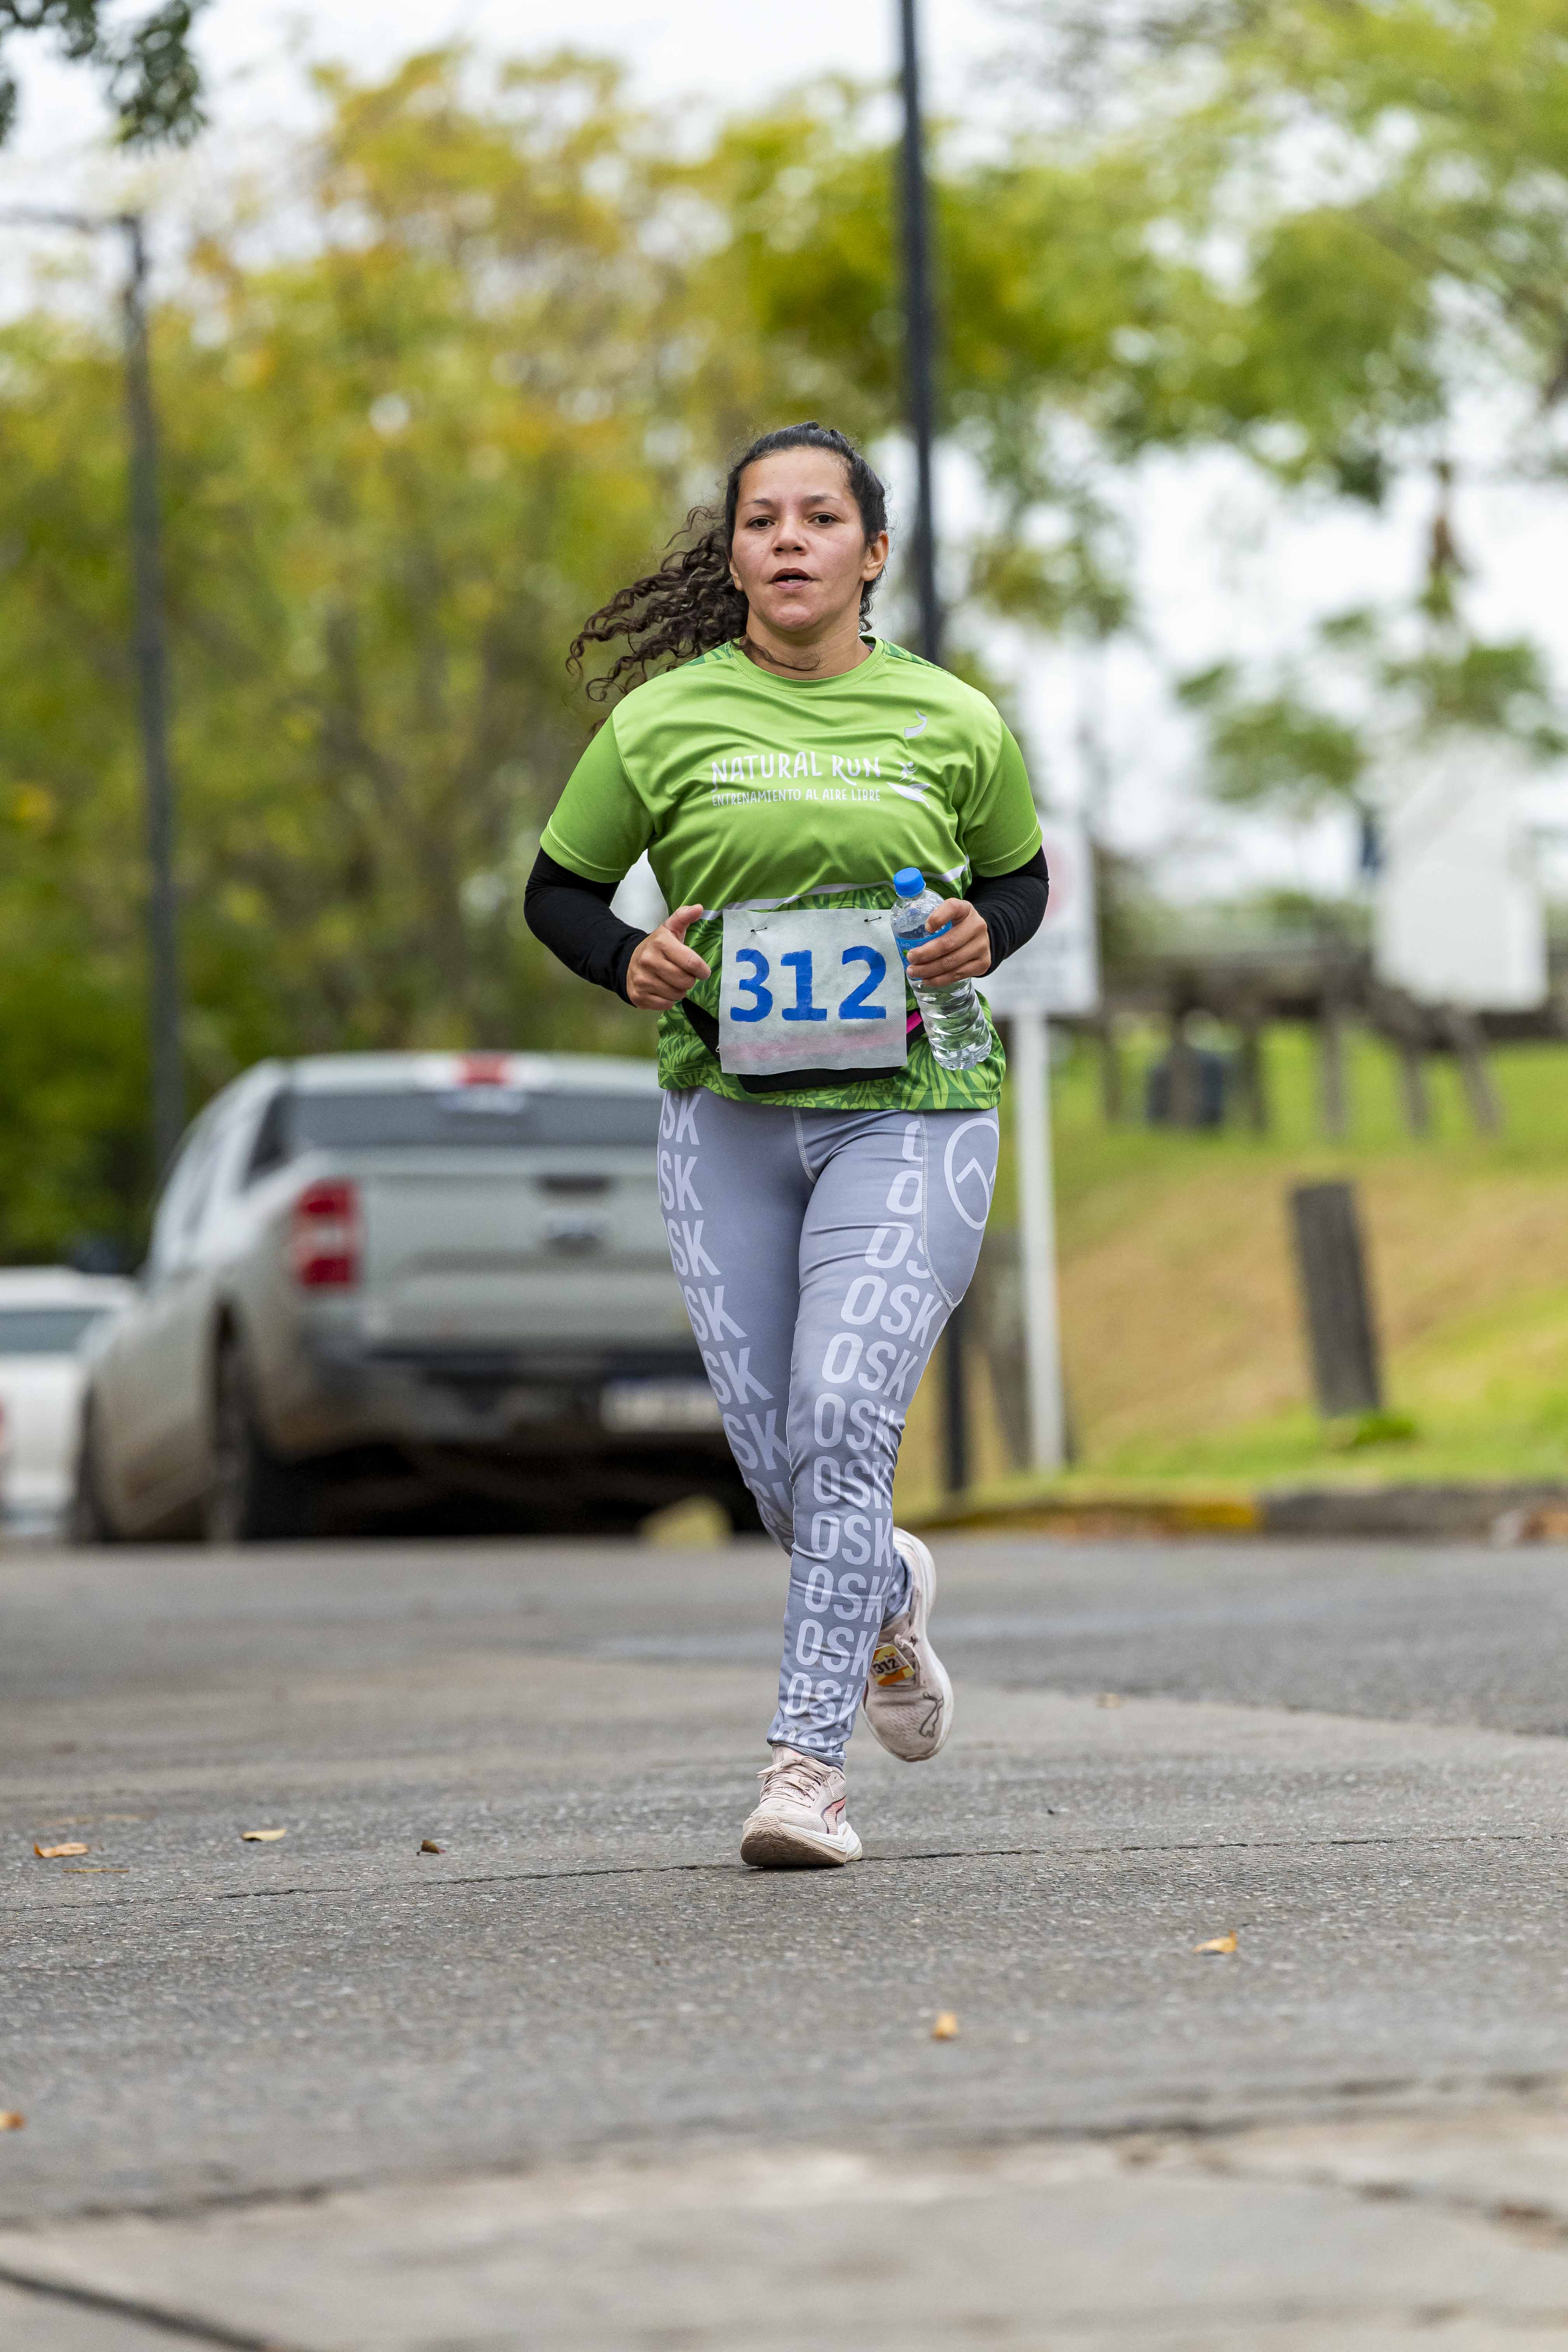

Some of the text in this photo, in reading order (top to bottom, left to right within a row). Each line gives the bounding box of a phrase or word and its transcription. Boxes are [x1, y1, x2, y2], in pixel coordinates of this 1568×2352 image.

[710, 751, 881, 793] NATURAL RUN
[712, 789, 881, 806] ENTRENAMIENTO AL AIRE LIBRE
[730, 945, 887, 1022] 312
[659, 1089, 701, 1145] SK
[658, 1150, 704, 1211] SK
[665, 1218, 721, 1277] SK
[841, 1275, 943, 1349] OSK
[822, 1332, 919, 1402] OSK
[814, 1393, 896, 1455] OSK
[813, 1456, 893, 1509] OSK
[811, 1511, 892, 1567] OSK
[805, 1566, 889, 1624] OSK
[796, 1619, 877, 1677] OSK
[873, 1658, 900, 1674] 312
[784, 1672, 863, 1731] OSK
